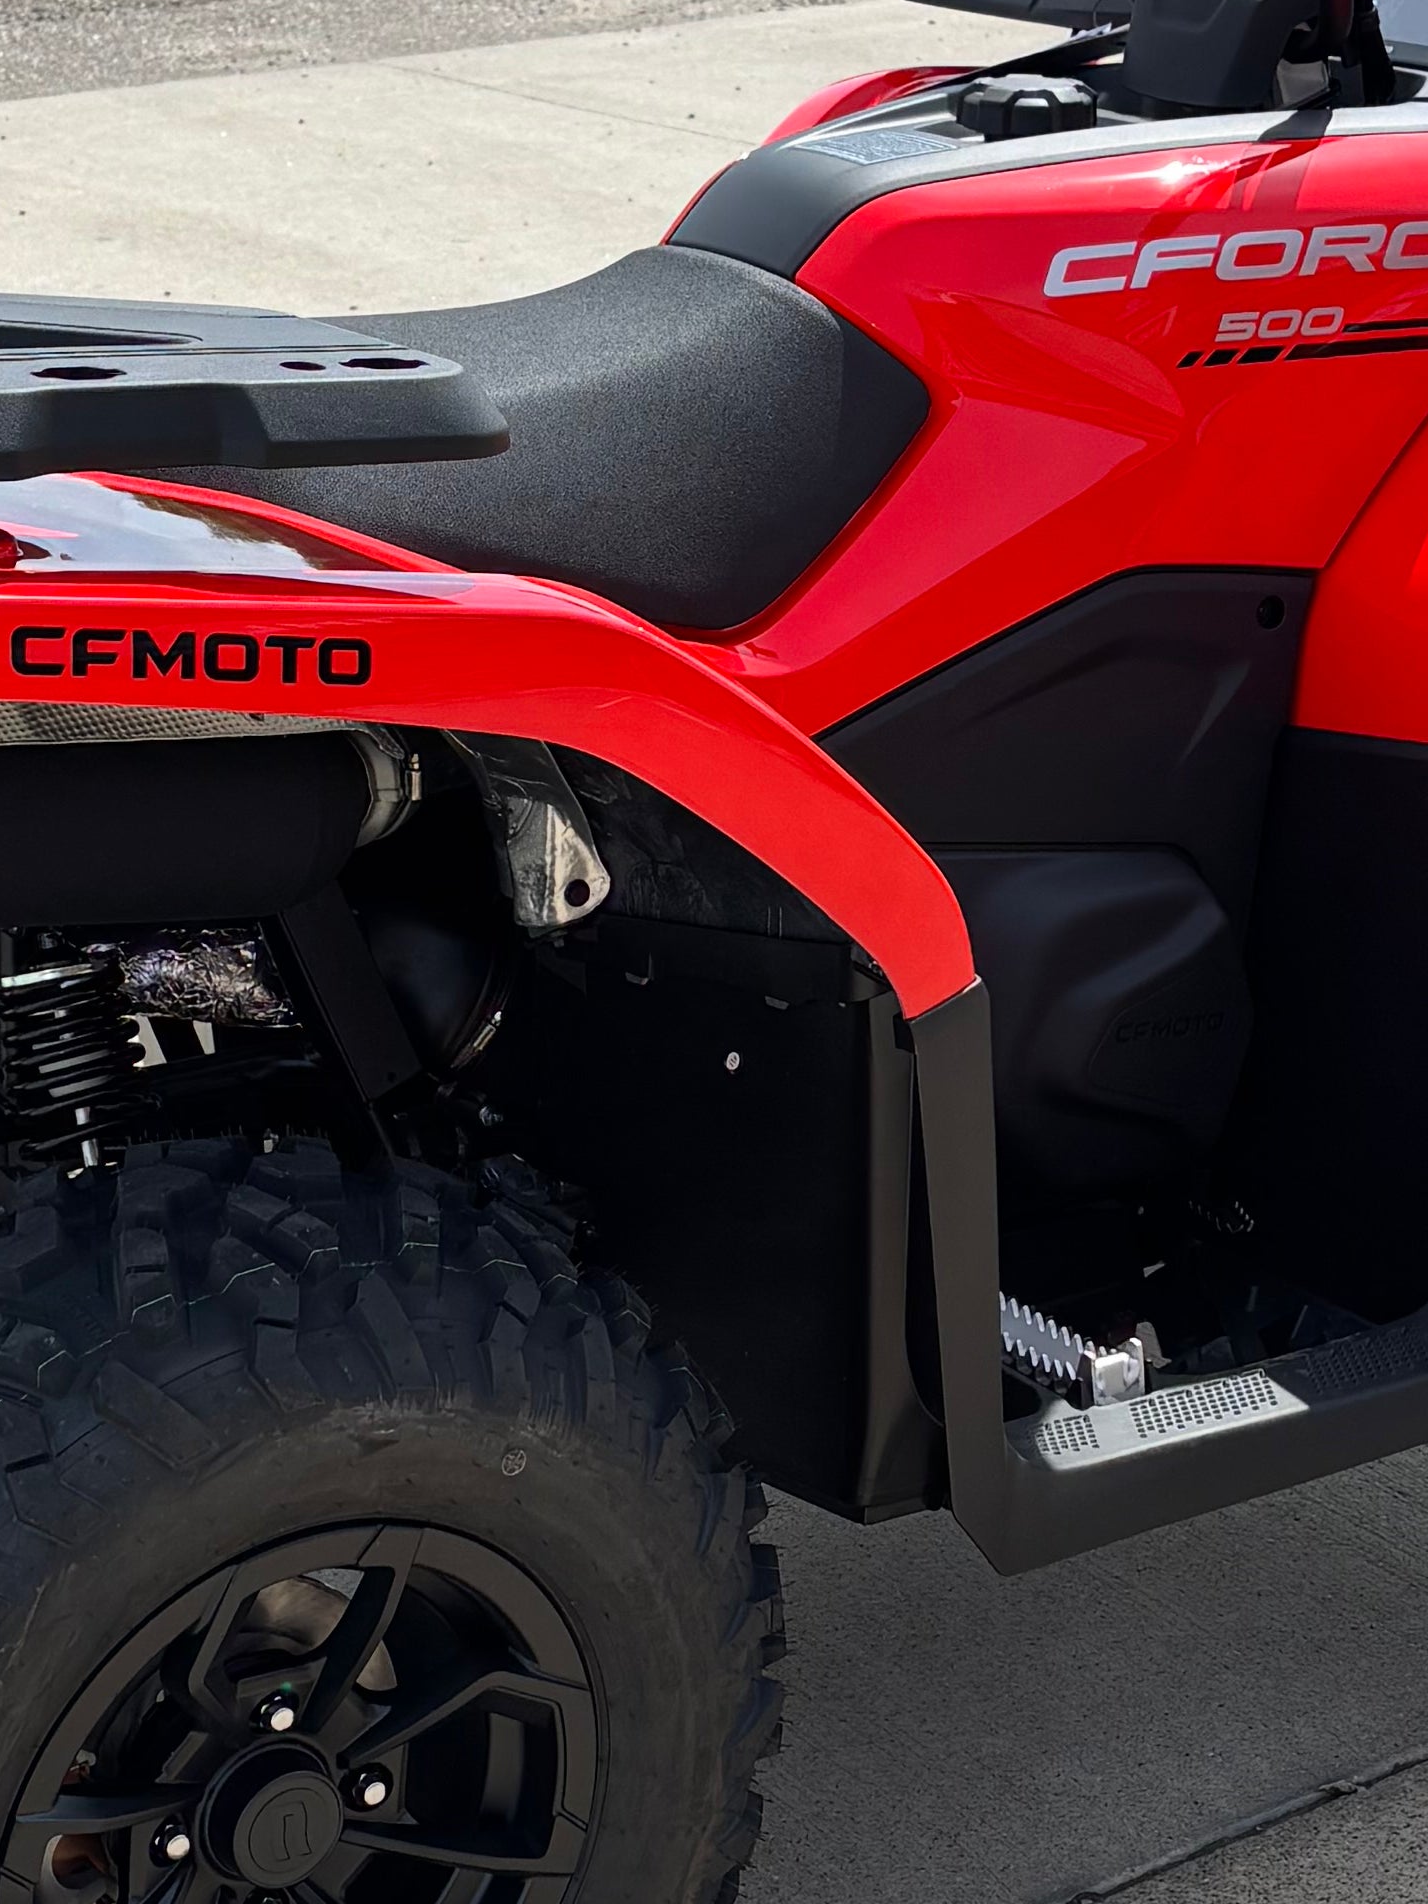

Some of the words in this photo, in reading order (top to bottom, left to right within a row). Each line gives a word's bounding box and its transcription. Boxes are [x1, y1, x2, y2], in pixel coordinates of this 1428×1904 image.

[1214, 306, 1345, 343] 500
[10, 625, 373, 686] CFMOTO
[1115, 1010, 1225, 1044] CFMOTO
